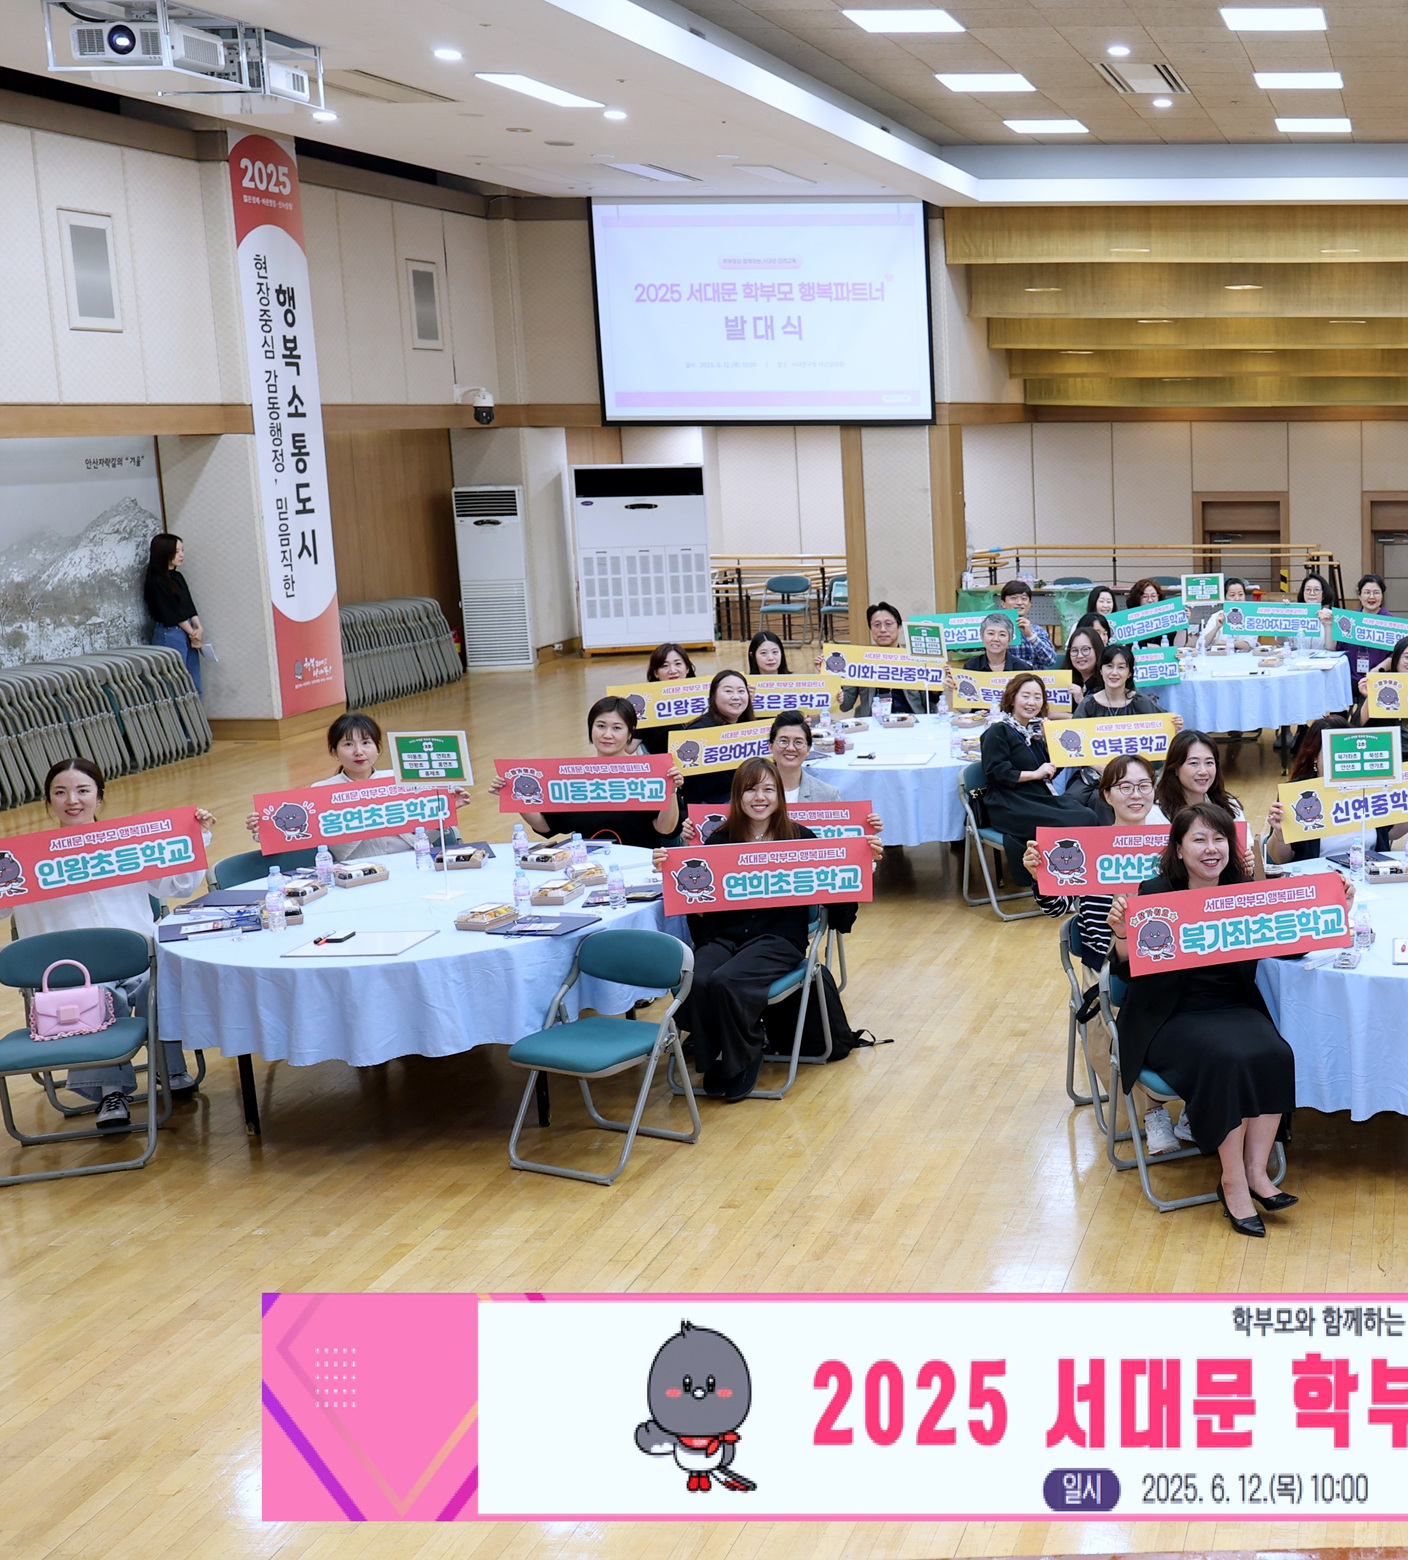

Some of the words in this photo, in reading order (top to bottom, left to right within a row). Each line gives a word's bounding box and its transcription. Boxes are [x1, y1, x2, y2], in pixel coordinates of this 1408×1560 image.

[240, 157, 291, 195] 2025
[634, 283, 682, 303] 2025
[686, 282, 739, 303] 서대문
[742, 281, 795, 303] 학부모
[798, 281, 886, 303] 행복파트너
[253, 254, 275, 360] 현장중심
[275, 496, 296, 599] 믿음직한
[1246, 618, 1319, 632] 중앙여자고등학교
[663, 687, 681, 695] 서대문
[795, 681, 825, 689] 행복파트너
[753, 693, 829, 711] 홍은중학교
[1096, 723, 1113, 731] 서대문
[1133, 721, 1161, 729] 행복파트너
[722, 731, 741, 740] 서대문
[1091, 735, 1166, 756] 연북중학교
[560, 765, 584, 774] 서대문
[585, 765, 608, 774] 학부모
[610, 763, 650, 773] 행복파트너
[332, 791, 360, 804] 서대문
[361, 787, 387, 800] 학부모
[551, 779, 664, 801] 미동초등학교
[321, 797, 447, 836] 홍연초등학교
[809, 810, 849, 820] 행복파트너
[50, 837, 83, 850] 서대문
[85, 829, 119, 844] 학부모
[119, 821, 171, 838] 행복파트너
[1114, 835, 1143, 846] 서대문
[38, 838, 192, 887] 인왕초등학교
[739, 854, 768, 864] 서대문
[769, 851, 797, 862] 학부모
[799, 848, 845, 860] 행복파트너
[726, 867, 860, 898] 연희초등학교
[1204, 897, 1233, 912] 서대문
[1236, 893, 1265, 908] 학부모
[1267, 887, 1315, 904] 행복파트너
[1137, 907, 1169, 919] 반가워요
[1182, 907, 1345, 952] 북가좌초등학교
